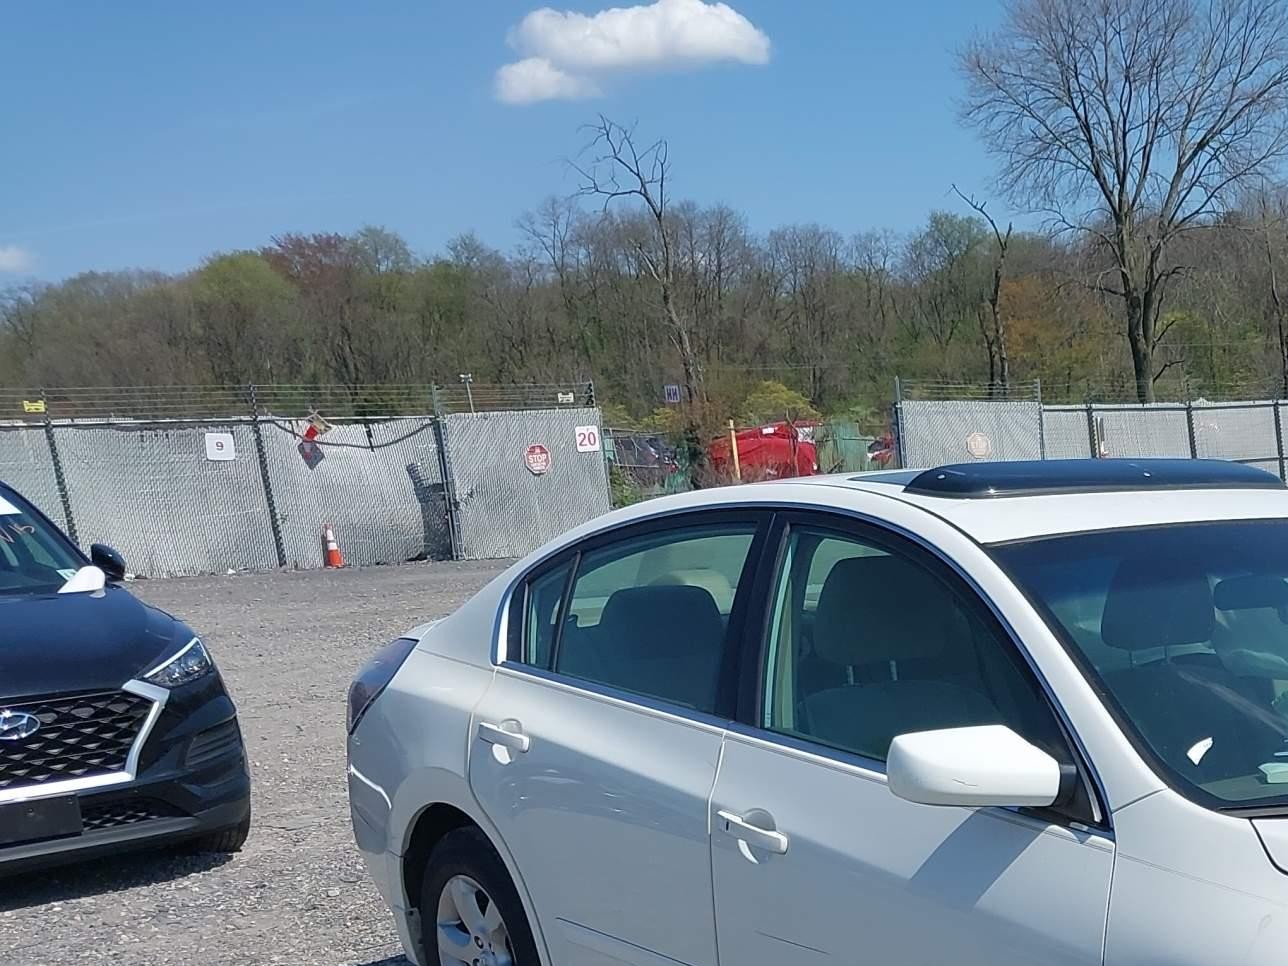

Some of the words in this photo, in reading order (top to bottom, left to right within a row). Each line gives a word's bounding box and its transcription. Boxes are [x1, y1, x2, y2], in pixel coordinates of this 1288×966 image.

[578, 432, 597, 446] 20
[215, 441, 224, 451] 9
[528, 454, 548, 463] STOP
